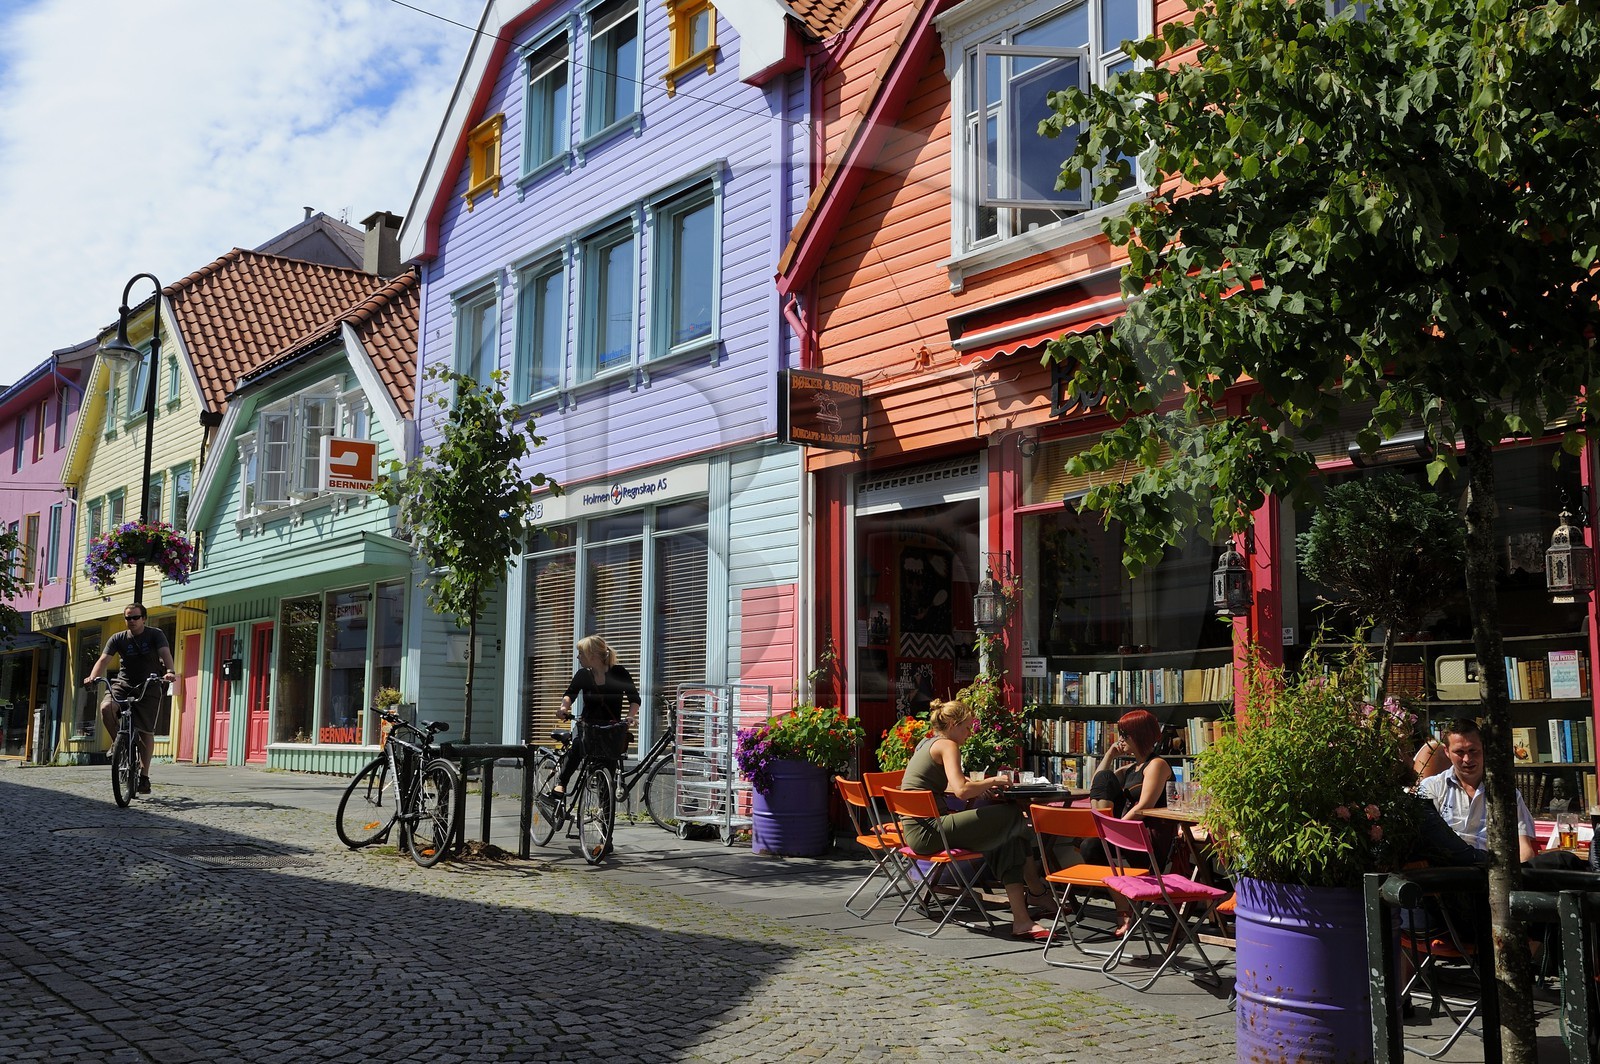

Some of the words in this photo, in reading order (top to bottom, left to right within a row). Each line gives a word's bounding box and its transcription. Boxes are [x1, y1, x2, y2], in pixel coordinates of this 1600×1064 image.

[792, 375, 823, 390] BØKER
[824, 380, 831, 391] &
[832, 380, 861, 398] BØRST
[329, 480, 374, 491] BERNINA
[582, 489, 611, 506] Holmen
[623, 483, 656, 500] Regnskap
[657, 478, 668, 490] AS
[320, 727, 354, 743] BERNINA
